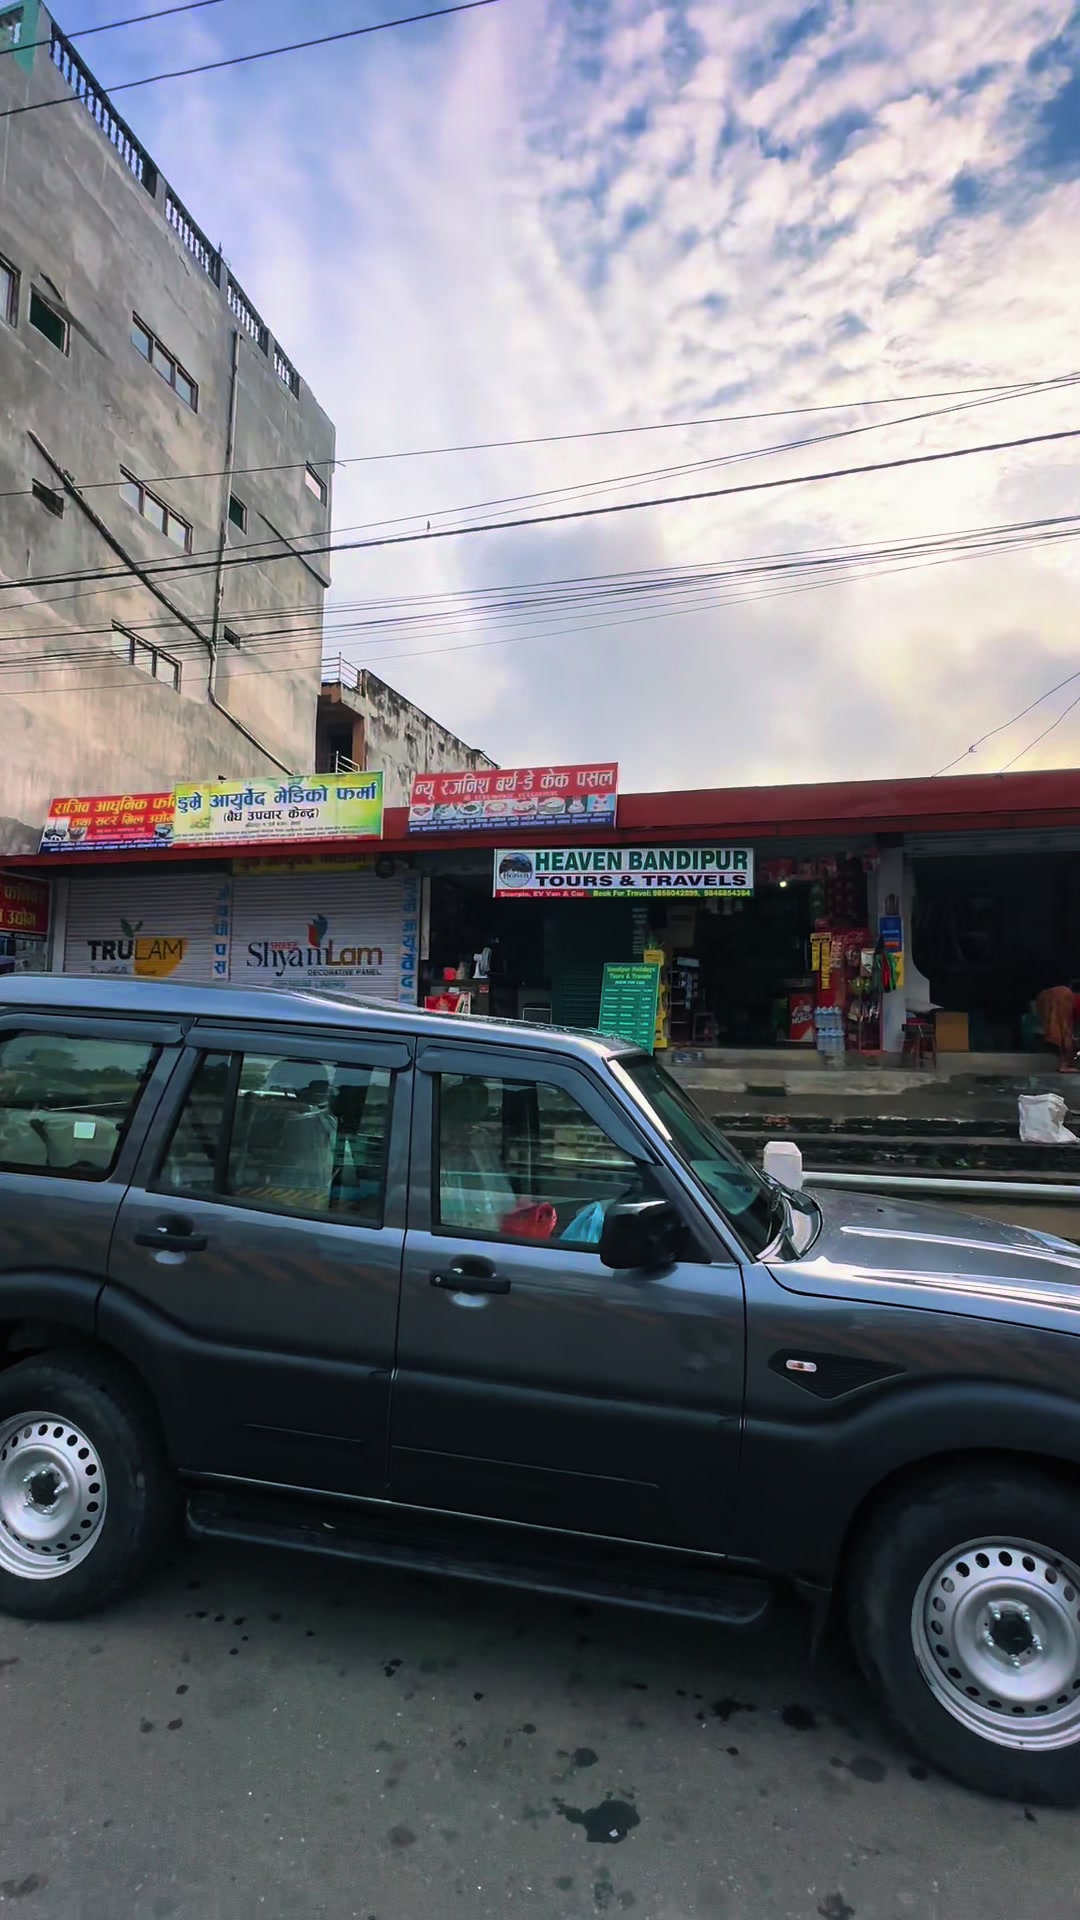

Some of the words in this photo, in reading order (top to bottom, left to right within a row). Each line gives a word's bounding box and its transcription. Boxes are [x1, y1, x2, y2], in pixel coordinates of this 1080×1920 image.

[415, 779, 435, 799] न्यू
[440, 773, 491, 797] रजनिश
[496, 770, 535, 791] बर्थ-डे
[540, 768, 569, 788] केक
[576, 768, 615, 787] पसल
[54, 798, 91, 815] राजिव
[94, 796, 147, 814] आधुनिक
[177, 791, 203, 813] डुम्रे
[209, 788, 267, 809] आयुर्वेद
[274, 784, 329, 804] मेडिको
[336, 781, 377, 801] फर्मा
[247, 808, 282, 821] उपचार
[288, 806, 320, 820] केन्द्र)
[535, 851, 622, 871] HEAVEN
[628, 850, 748, 870] BANDIPUR
[535, 875, 613, 887] TOURS
[619, 875, 636, 887] &
[641, 875, 747, 887] TRAVELS
[500, 890, 531, 898] Scorpio,
[592, 889, 611, 897] Book
[612, 889, 625, 897] For
[626, 889, 651, 897] Travel:
[87, 940, 184, 961] TRULAM
